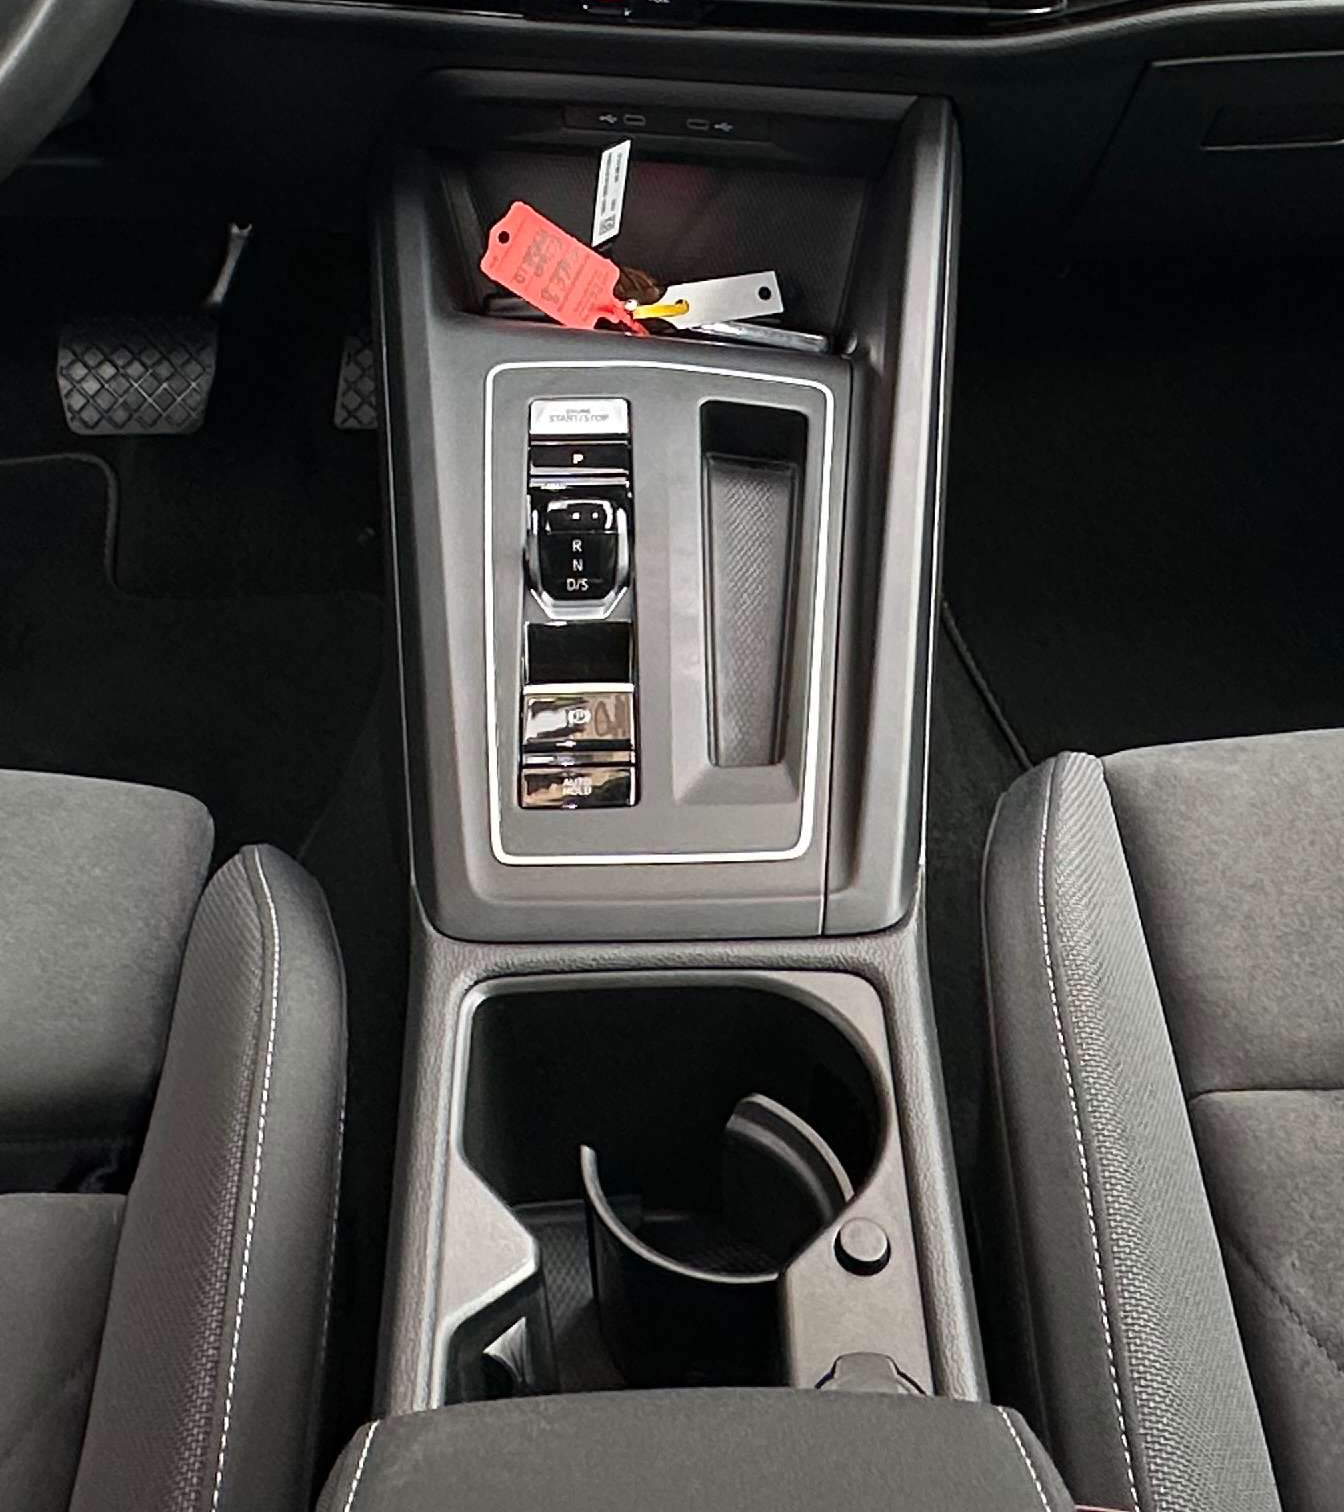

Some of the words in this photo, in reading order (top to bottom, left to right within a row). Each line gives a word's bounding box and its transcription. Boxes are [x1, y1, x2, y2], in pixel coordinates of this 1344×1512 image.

[572, 453, 584, 464] P
[572, 539, 583, 552] R
[572, 559, 584, 571] N
[566, 578, 589, 591] D/S
